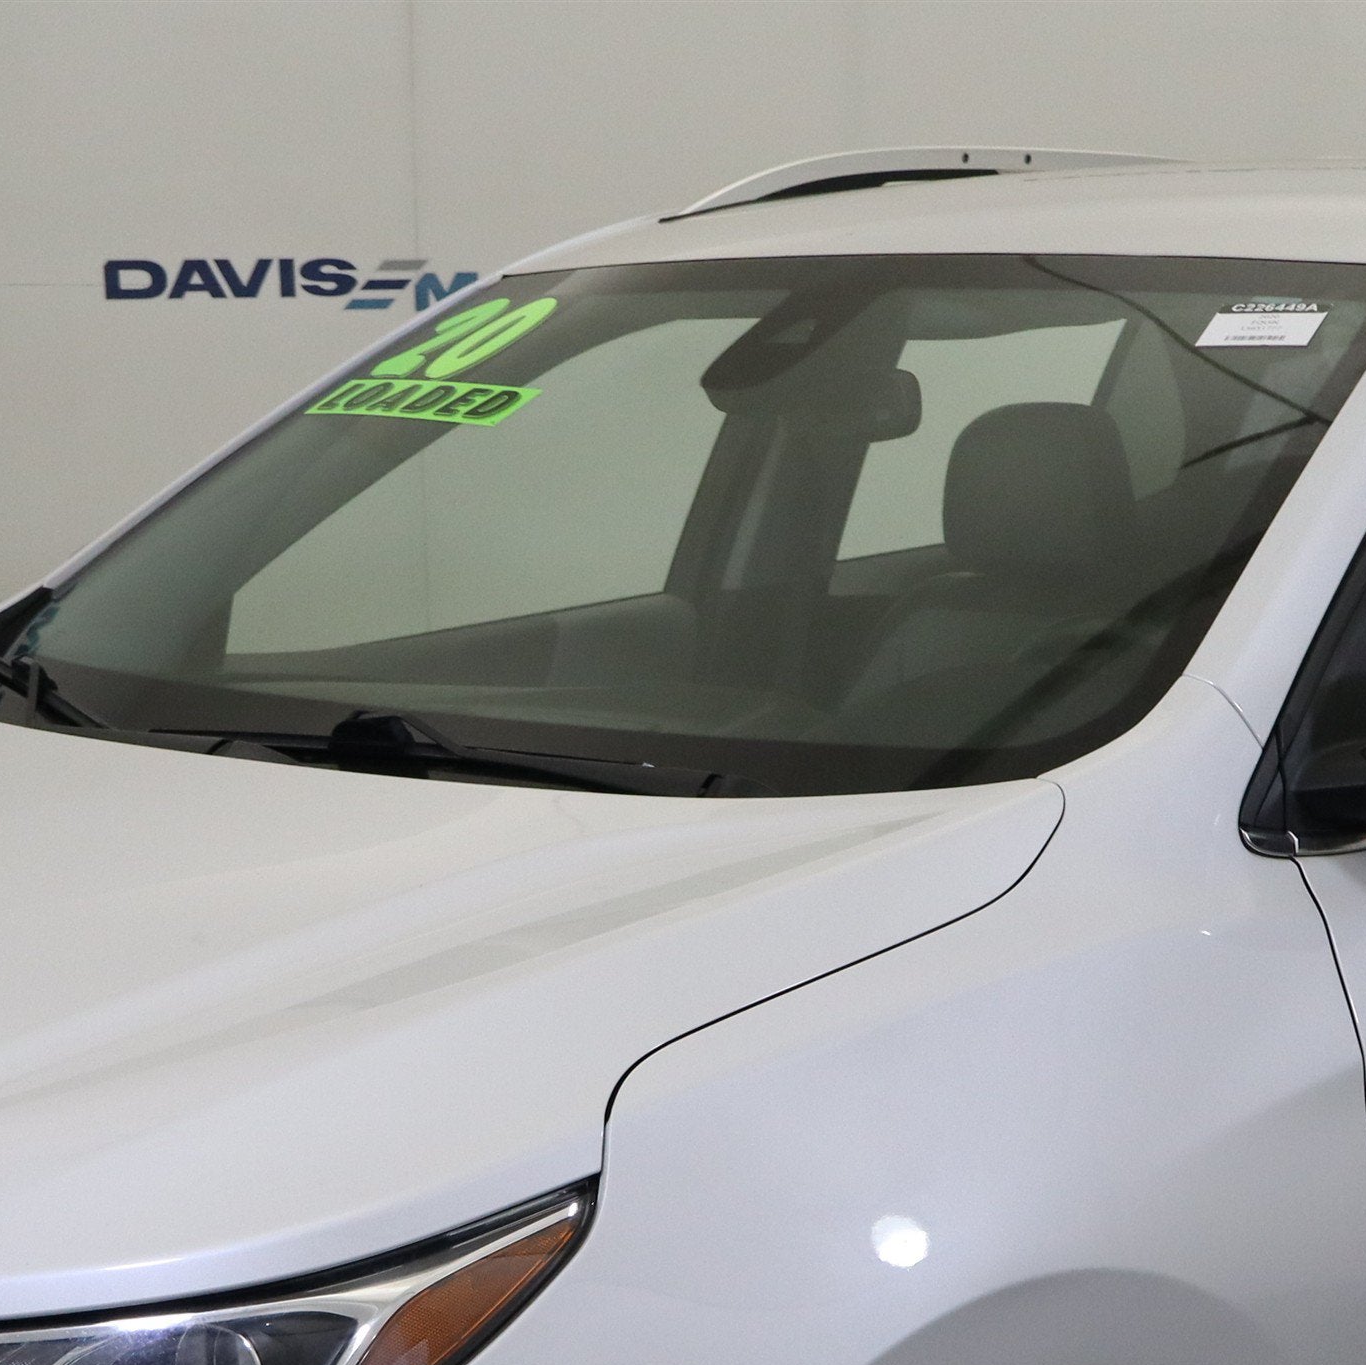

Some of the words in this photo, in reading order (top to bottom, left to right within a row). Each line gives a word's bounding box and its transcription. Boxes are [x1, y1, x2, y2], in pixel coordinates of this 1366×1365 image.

[103, 258, 357, 300] DAVIS
[370, 297, 558, 379] 20
[317, 382, 524, 419] LOADED
